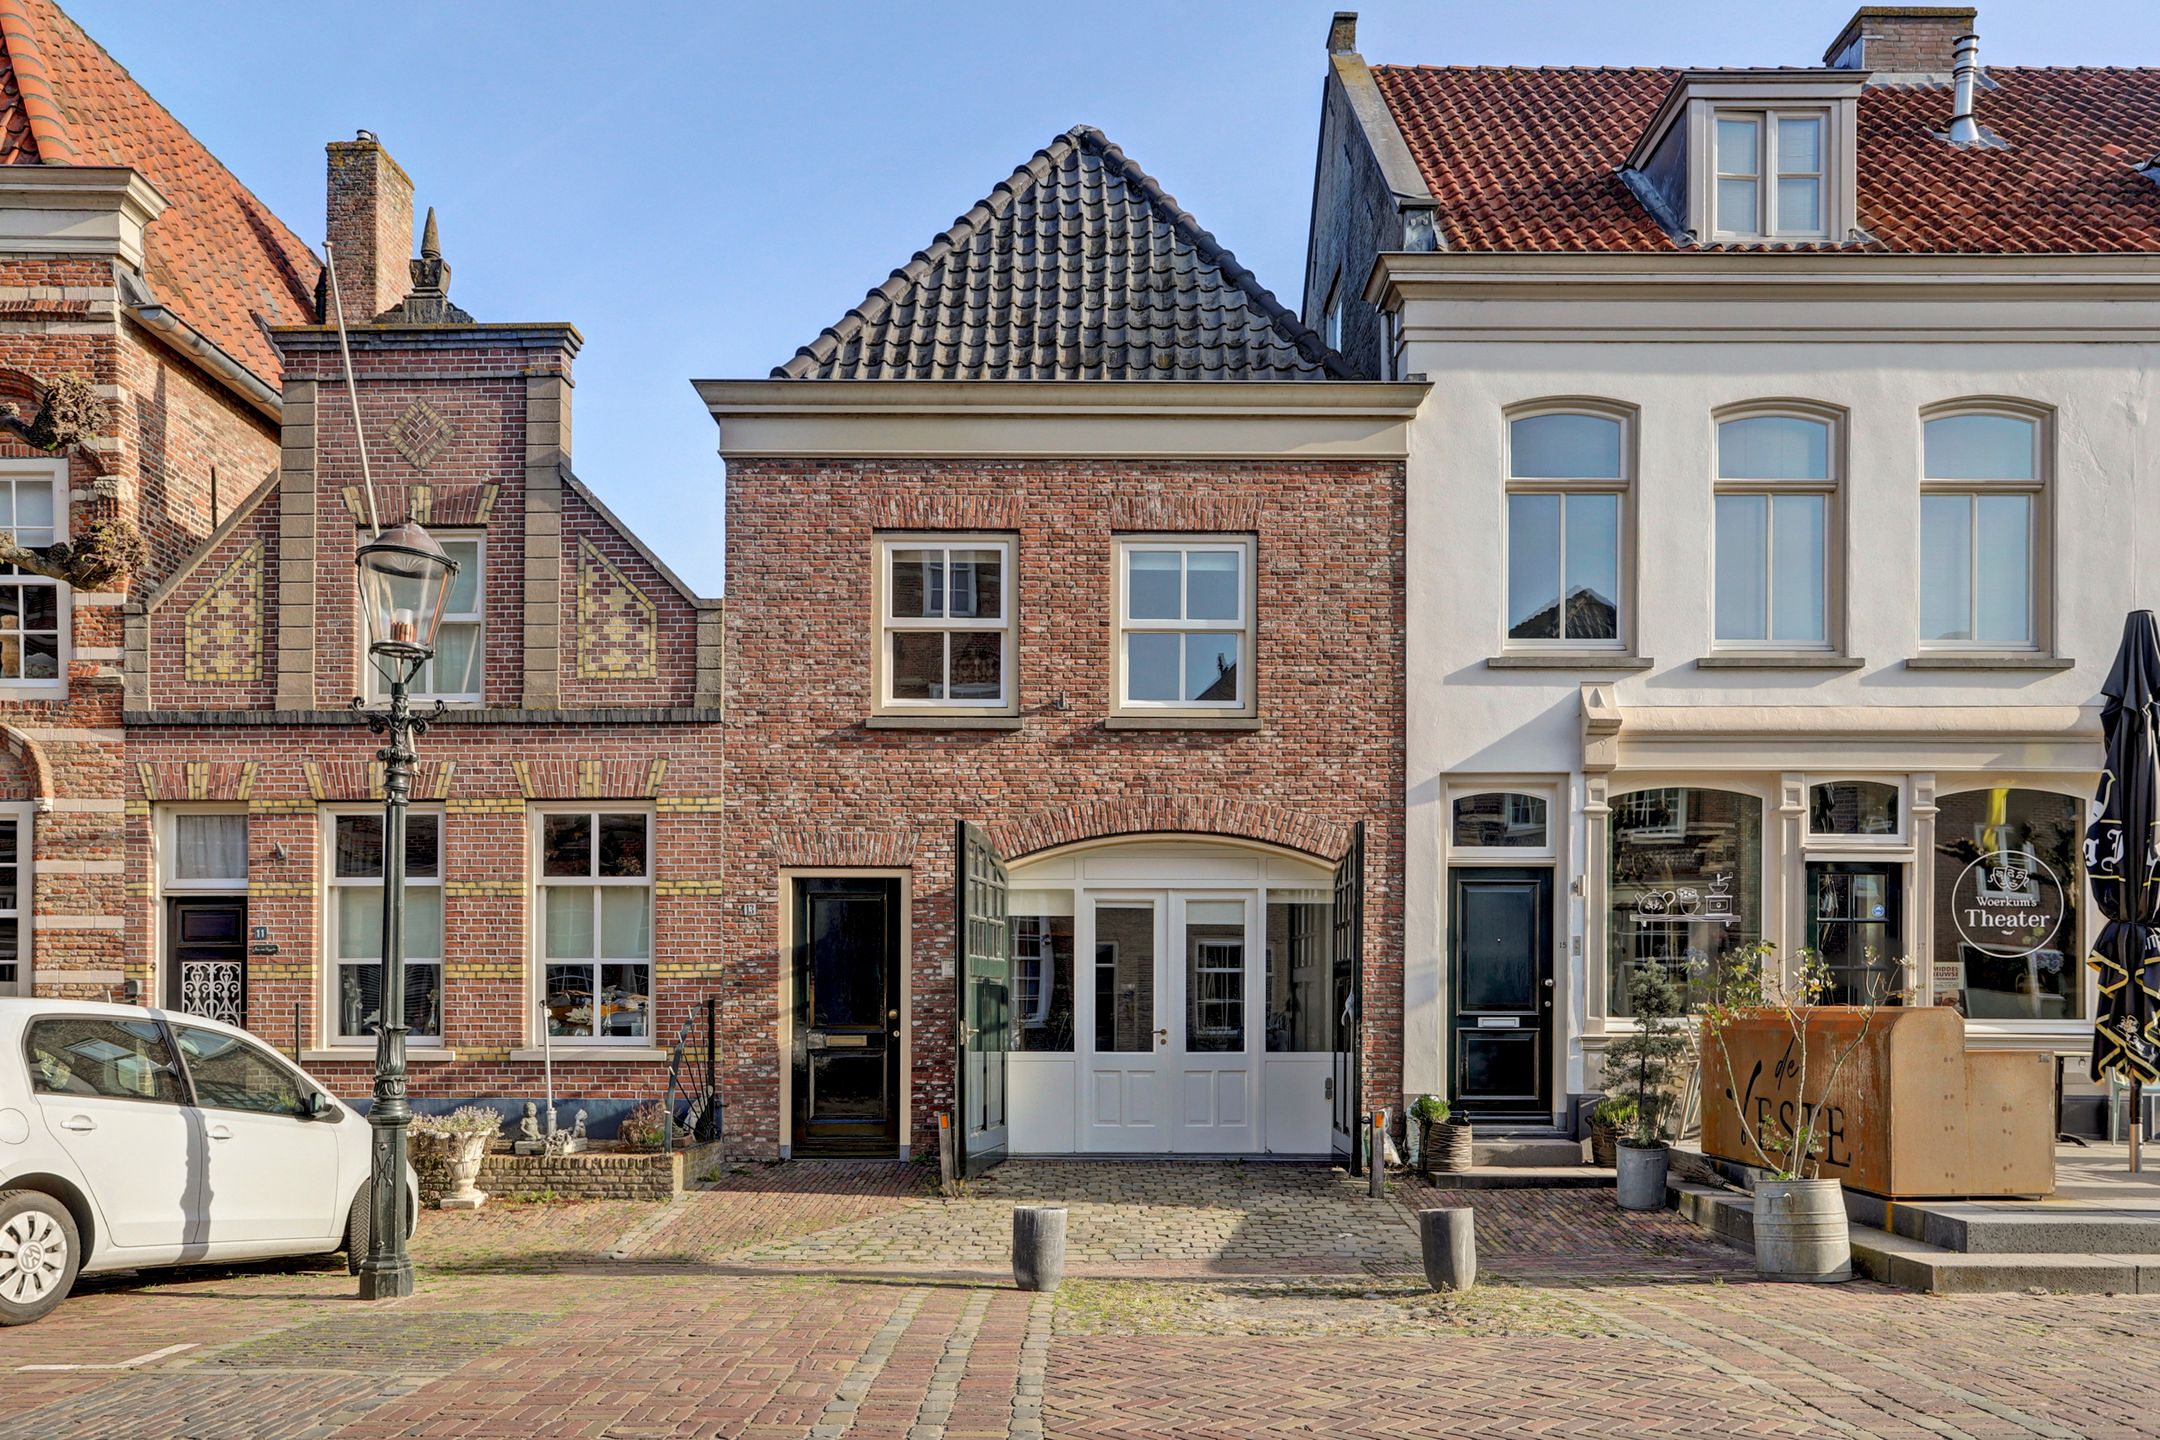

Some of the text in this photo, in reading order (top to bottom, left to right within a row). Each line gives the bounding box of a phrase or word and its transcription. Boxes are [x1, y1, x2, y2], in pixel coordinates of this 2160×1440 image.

[1976, 896, 2037, 907] Woerkum's
[1964, 909, 2050, 928] Theater
[256, 929, 265, 938] 11
[1559, 941, 1567, 949] 15
[1775, 1036, 1799, 1091] de
